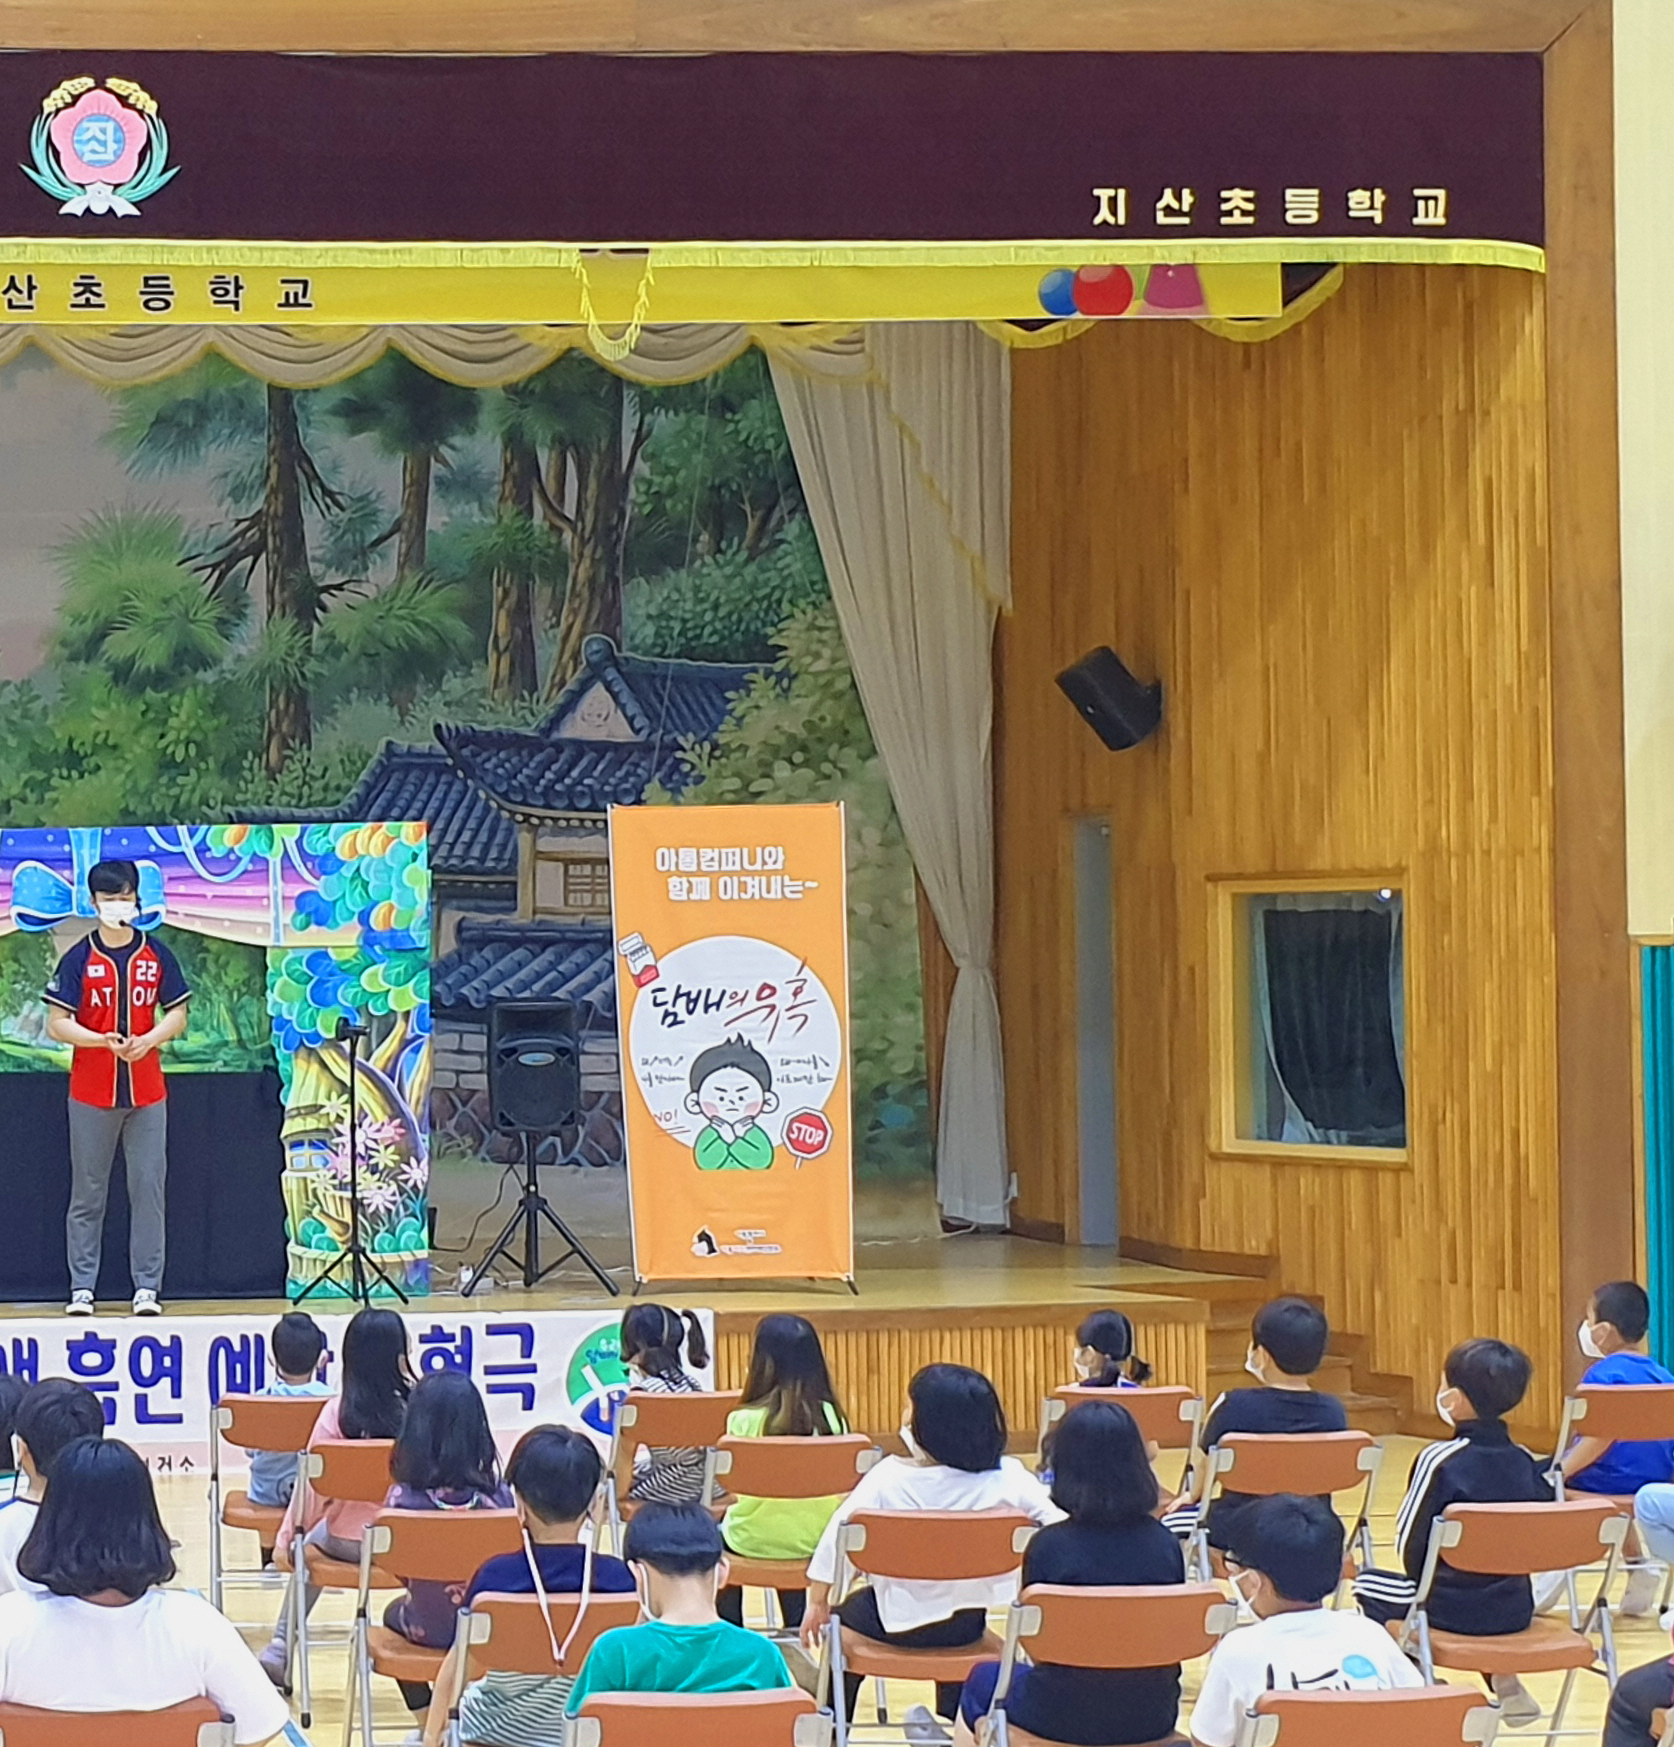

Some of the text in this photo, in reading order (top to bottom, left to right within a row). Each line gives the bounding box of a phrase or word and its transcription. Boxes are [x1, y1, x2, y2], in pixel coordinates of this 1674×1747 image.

[1092, 187, 1448, 226] 지산초등학교
[667, 875, 712, 900] 함께
[136, 960, 158, 982] 22
[789, 1122, 825, 1145] STOP
